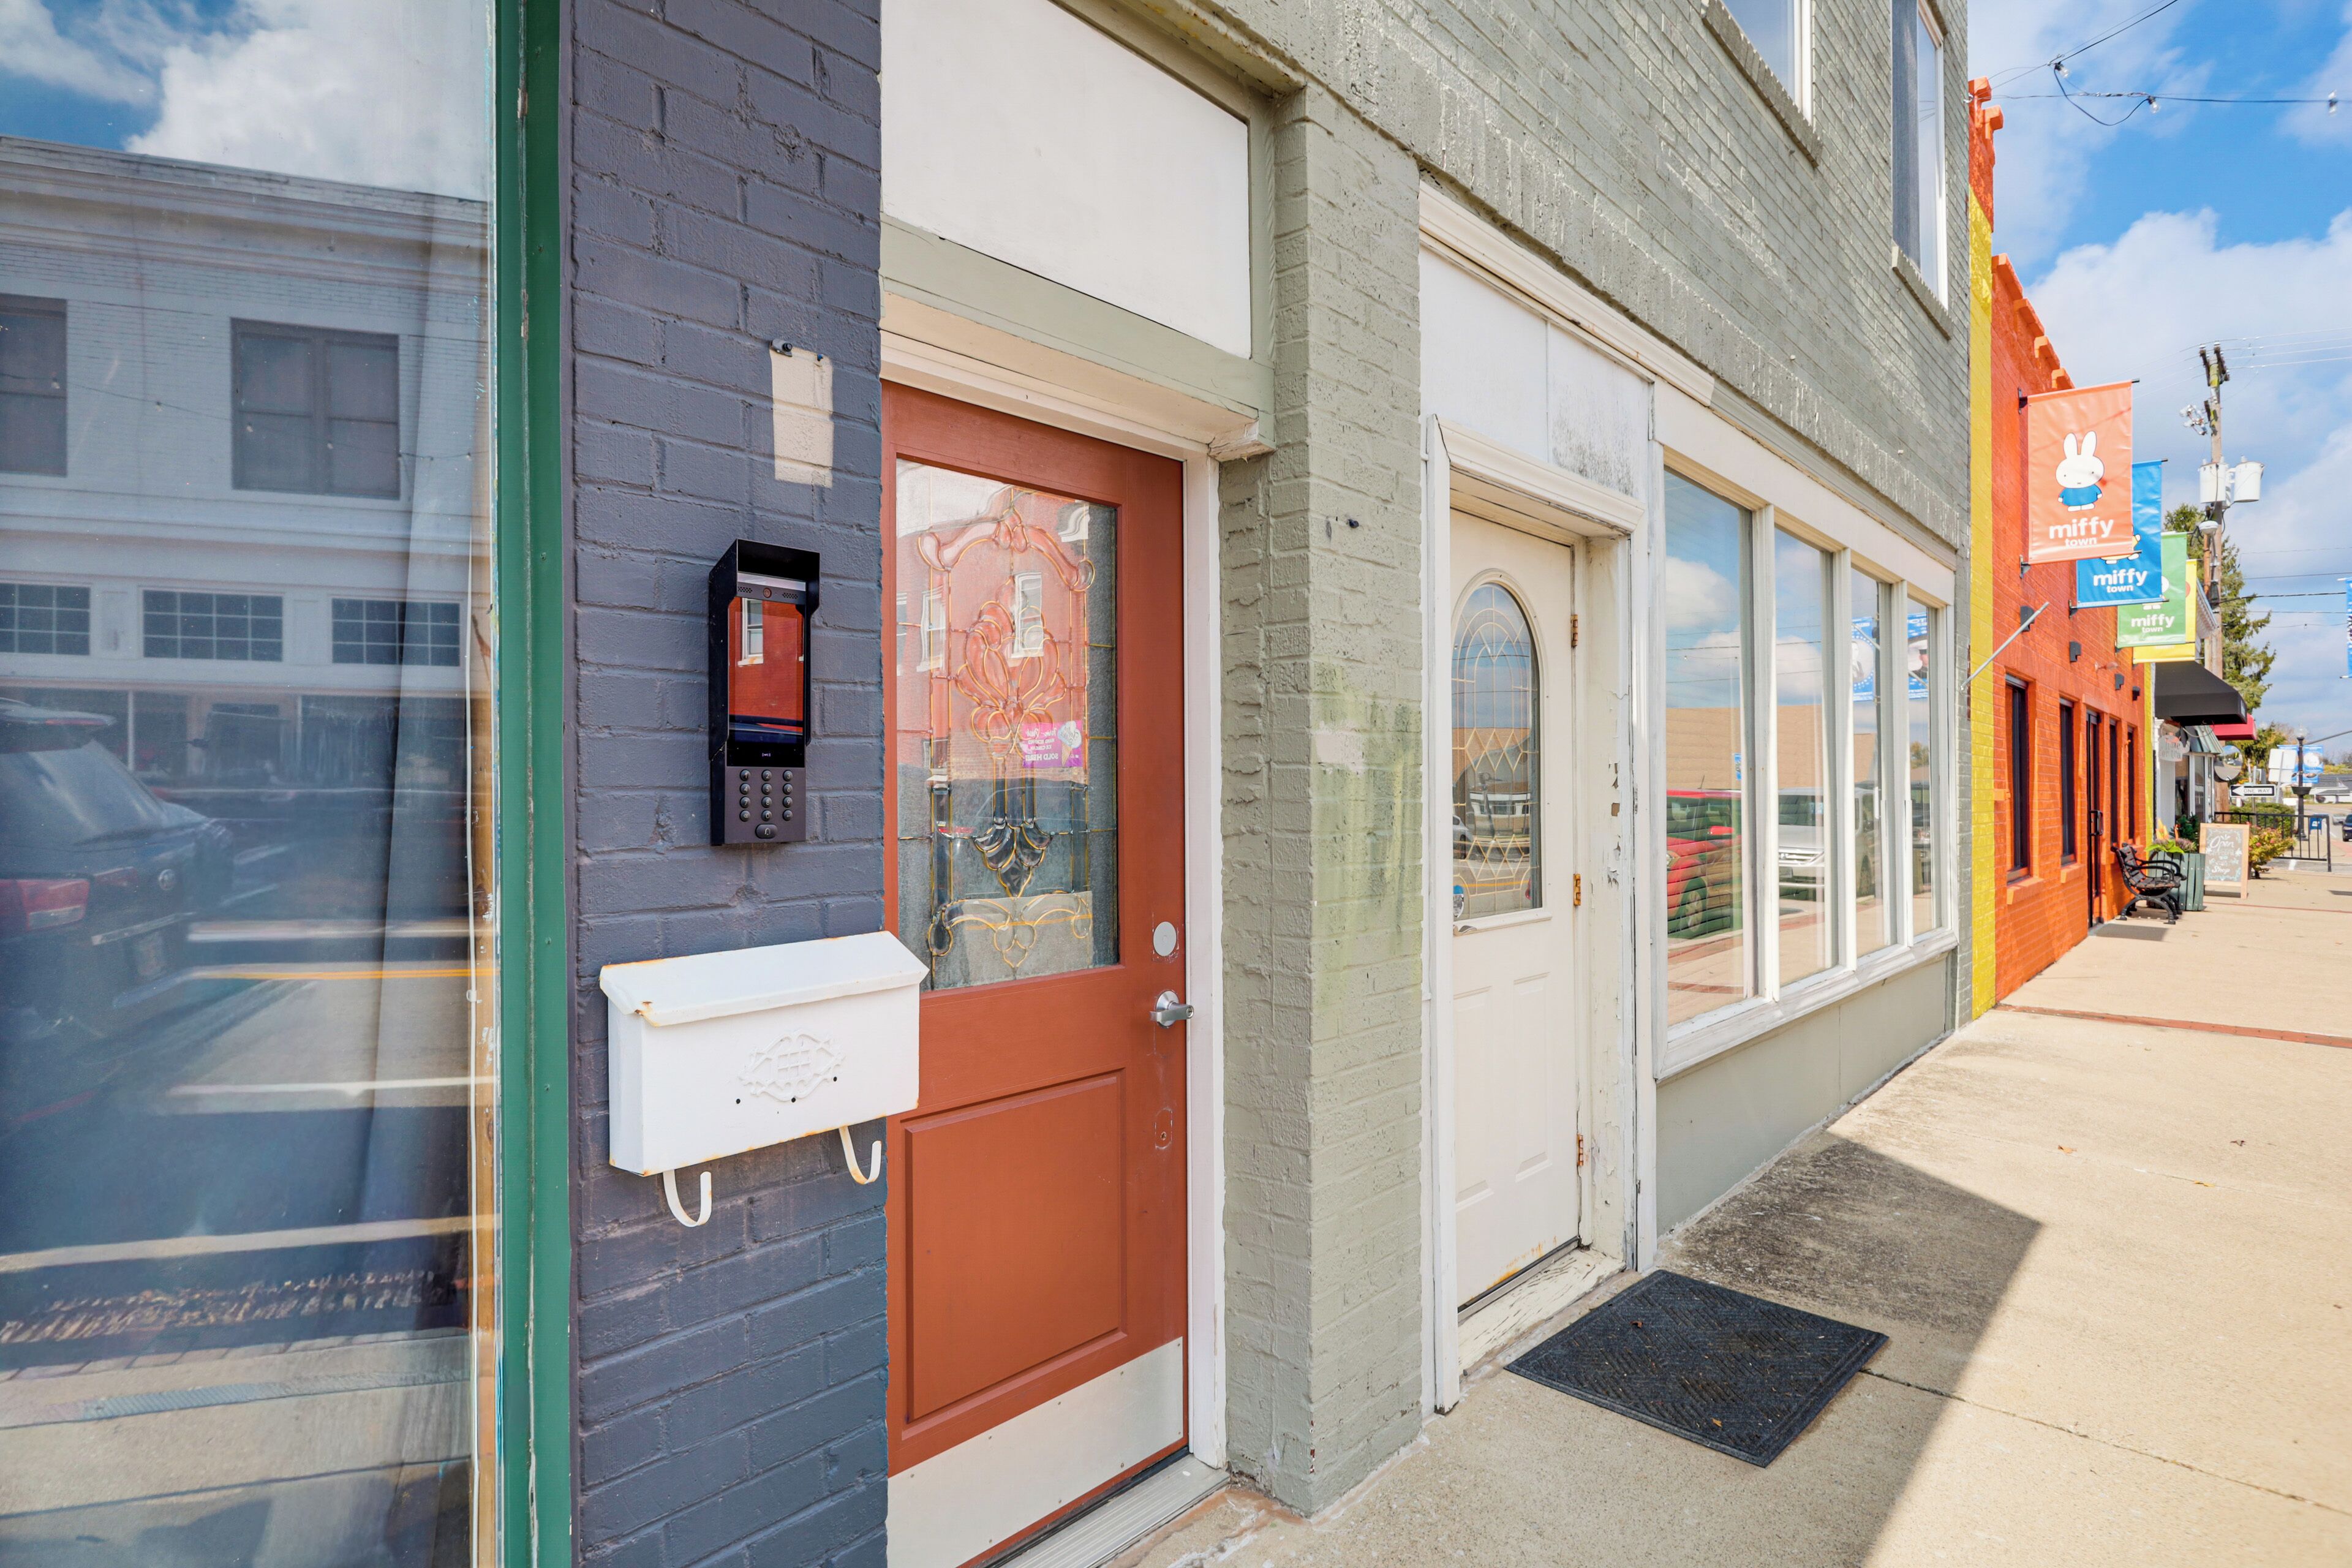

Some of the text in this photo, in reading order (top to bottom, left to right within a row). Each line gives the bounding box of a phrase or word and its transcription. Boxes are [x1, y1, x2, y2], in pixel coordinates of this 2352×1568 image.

[2049, 516, 2114, 540] miffy
[2064, 537, 2097, 547] town
[2093, 567, 2148, 587] miffy
[2106, 584, 2135, 594] town
[2131, 613, 2175, 628] miffy
[2209, 835, 2234, 852] Open
[2211, 865, 2230, 875] Shop
